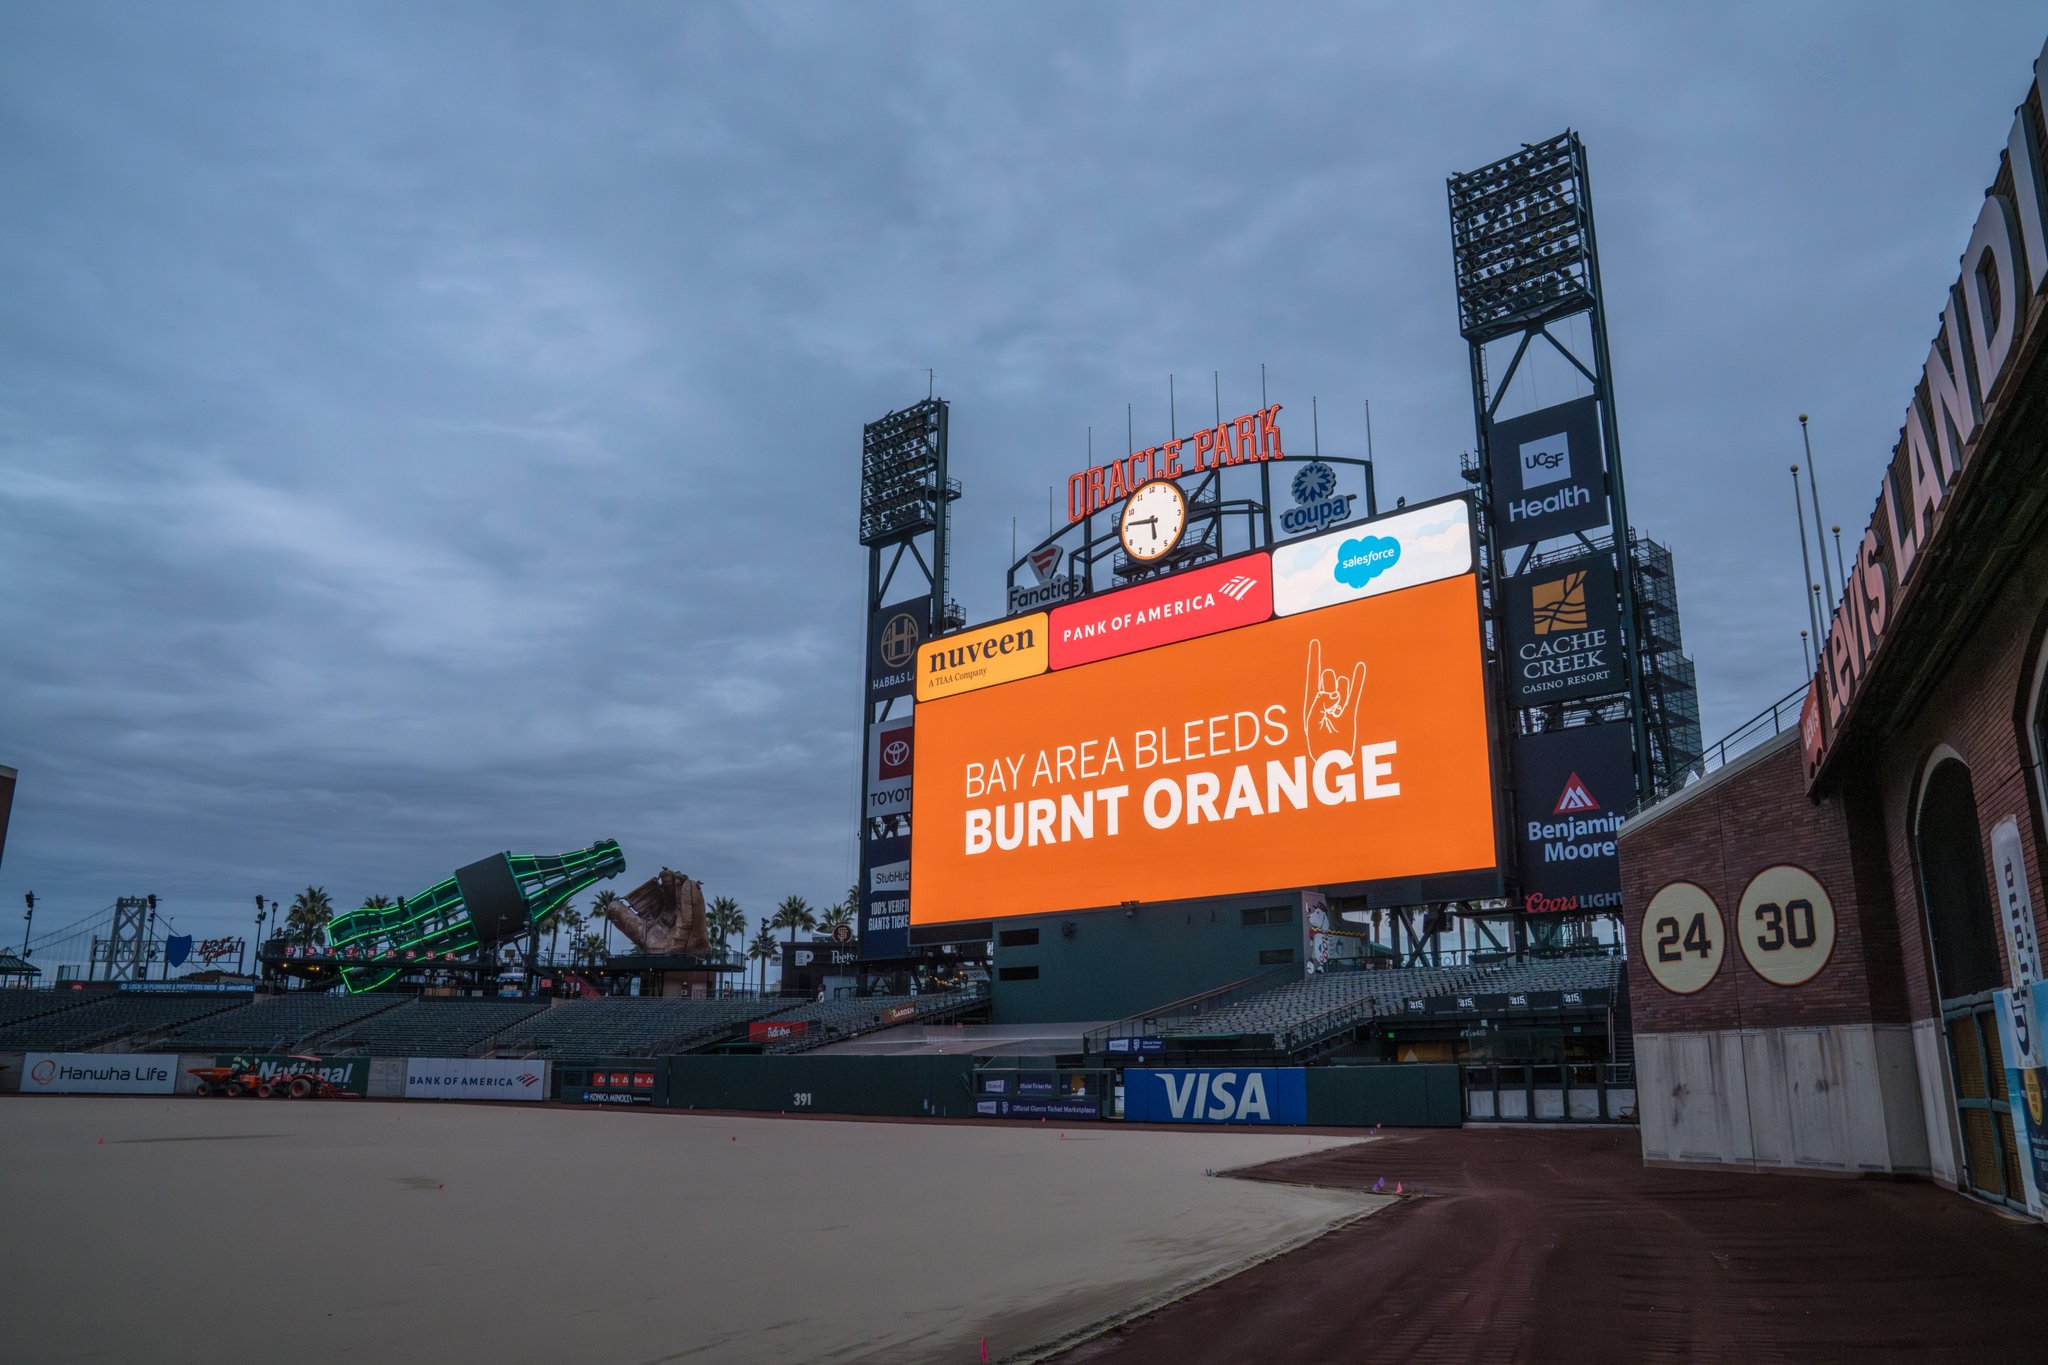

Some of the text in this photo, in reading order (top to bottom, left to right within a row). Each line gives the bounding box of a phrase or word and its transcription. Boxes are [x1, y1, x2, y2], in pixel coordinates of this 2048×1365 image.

[1068, 404, 1285, 524] ORACLE PARK
[1525, 452, 1564, 470] UCSF
[1283, 498, 1345, 529] coupa
[1508, 485, 1591, 522] Health
[1342, 548, 1395, 569] salesforce
[1009, 577, 1080, 611] Fanatics
[1111, 613, 1131, 632] OF
[1136, 593, 1216, 626] AMERICA
[929, 628, 1035, 674] nuveen
[1520, 629, 1607, 660] CACHE
[1523, 650, 1607, 679] CREEK
[872, 672, 906, 690] HABBAS
[928, 667, 988, 688] A TIAA Company
[1522, 670, 1611, 694] CASINO RESORT
[966, 704, 1289, 798] BAY AREA BLEEDS
[870, 787, 912, 806] TOYOT
[965, 740, 1401, 856] BURNT ORANGE
[1544, 840, 1616, 863] Moore
[887, 898, 910, 914] VERIFI
[1524, 892, 1579, 913] Coors
[868, 914, 910, 931] GIANTS TICKE
[1755, 898, 1816, 951] 30
[1655, 912, 1712, 963] 24
[1410, 1001, 1423, 1010] 415
[1459, 998, 1473, 1008] 415
[1511, 995, 1526, 1005] 415
[1565, 993, 1580, 1003] 415
[59, 1066, 168, 1081] Hanwha Life
[409, 1076, 513, 1087] BANK OF AMERICA
[793, 1092, 812, 1106] 391
[1154, 1072, 1271, 1120] VISA
[1012, 1104, 1096, 1115] Official Giants Ticket Marketplace
